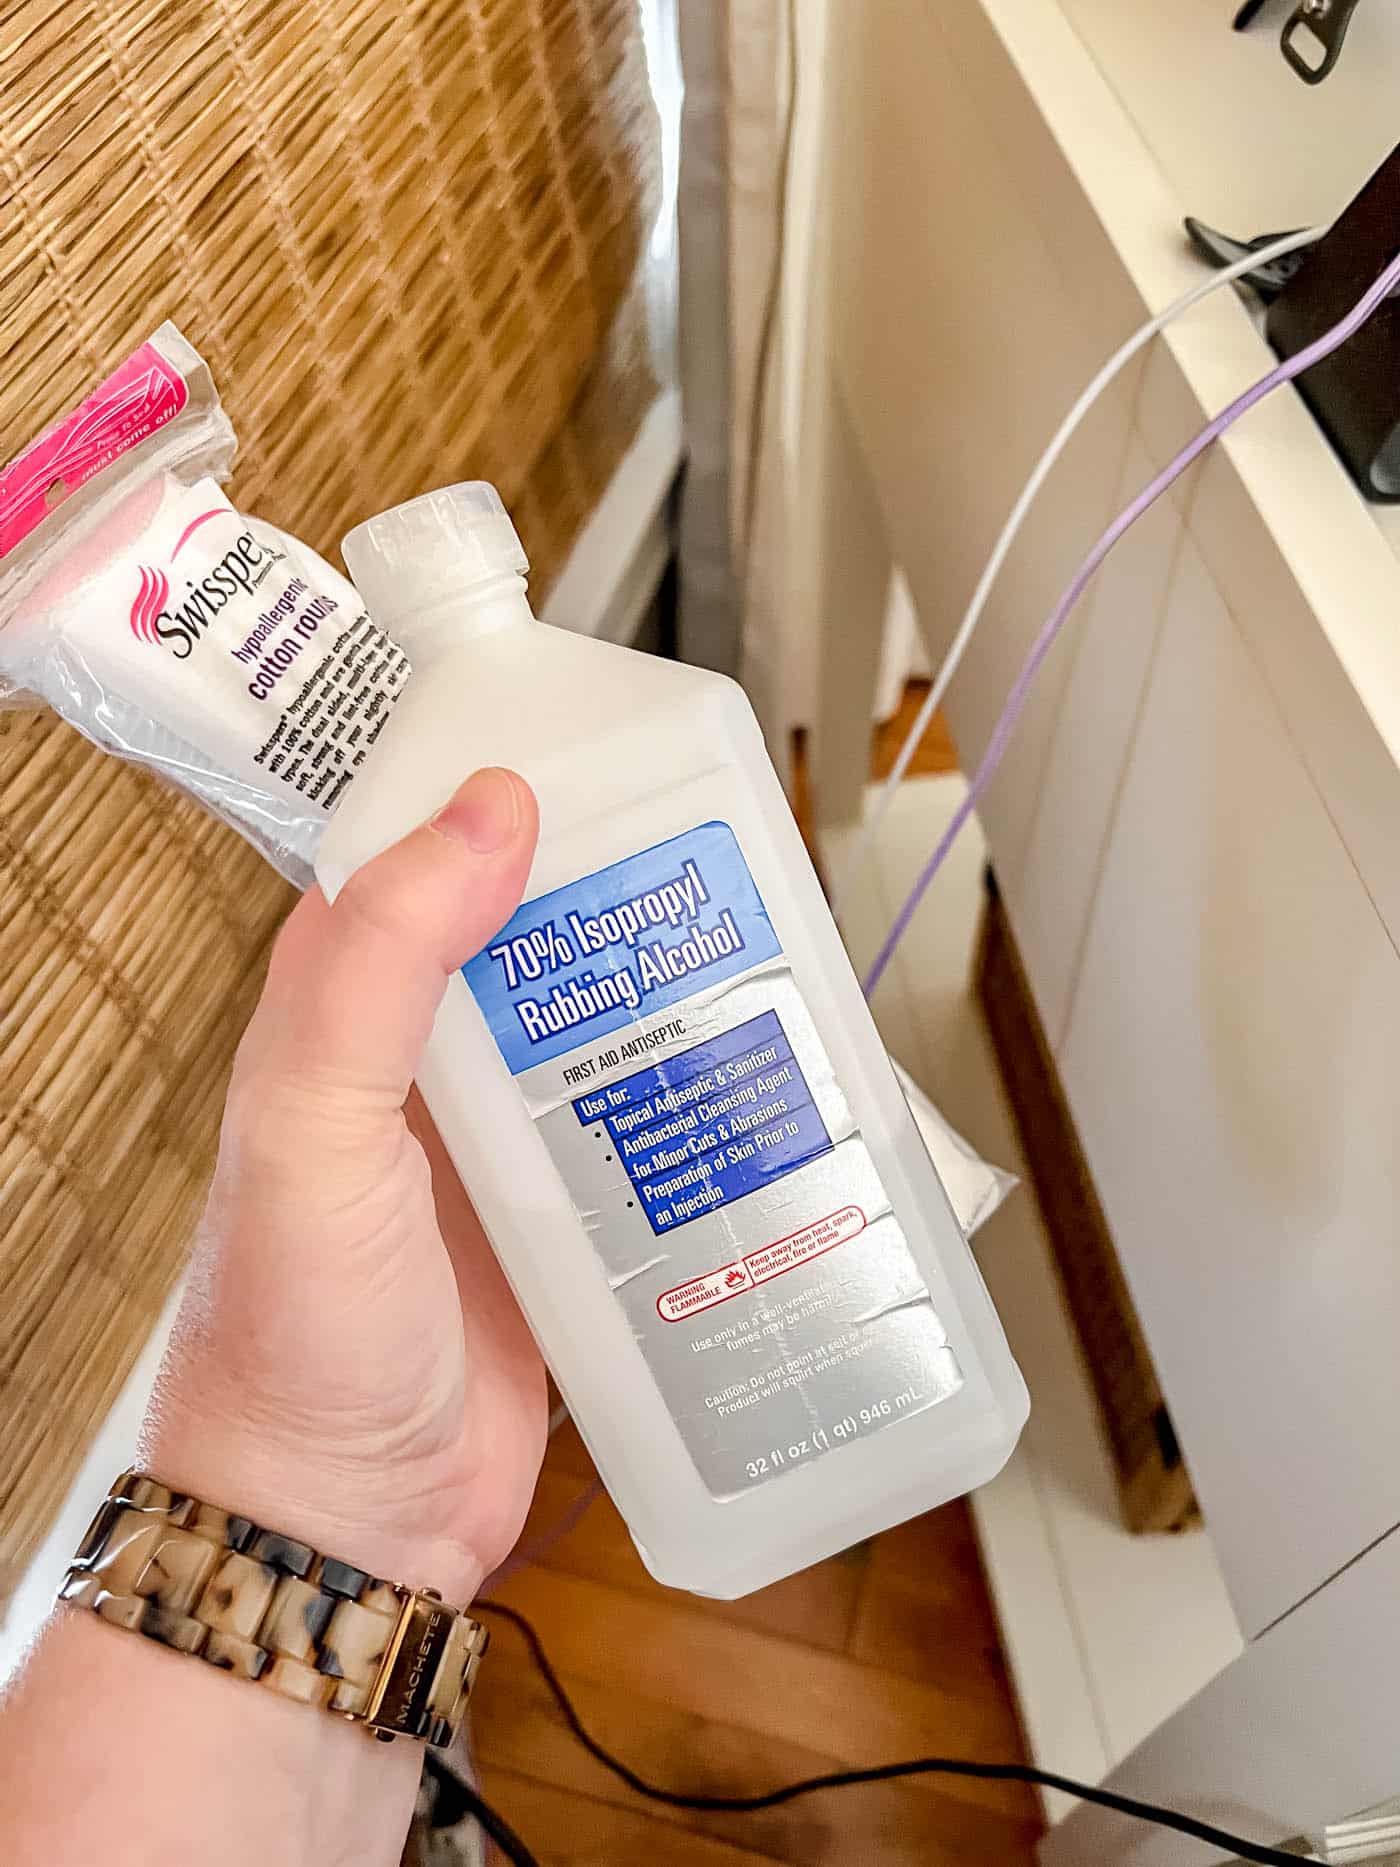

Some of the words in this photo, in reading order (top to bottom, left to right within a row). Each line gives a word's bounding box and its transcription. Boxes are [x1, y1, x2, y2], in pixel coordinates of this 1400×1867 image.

[117, 424, 150, 452] come
[154, 532, 265, 659] Swisspe
[231, 578, 308, 664] hypoallergeni
[248, 637, 303, 700] cotton
[269, 753, 286, 773] with
[299, 699, 323, 728] cotton
[490, 922, 574, 988] 70%
[569, 862, 709, 955] Isopropyl
[517, 970, 638, 1041] Rubbing
[636, 911, 742, 990] Alcohol
[562, 1058, 597, 1086] FIRST
[599, 1049, 621, 1074] AID
[621, 1019, 687, 1060] ANTISEPTIC
[580, 1098, 607, 1118] Use
[609, 1106, 655, 1133] Topical
[655, 1077, 715, 1114] Antiseptic
[716, 1068, 727, 1086] &
[727, 1046, 778, 1079] Sanitizer
[622, 1111, 699, 1157] Antibacterial
[698, 1087, 757, 1127] Cleansing
[757, 1066, 792, 1095] Agent
[633, 1163, 653, 1179] for
[651, 1144, 690, 1172] Minor
[689, 1132, 718, 1155] Cuts
[719, 1123, 731, 1141] &
[730, 1098, 788, 1135] Abrasions
[642, 1162, 713, 1203] Preparation
[715, 1155, 727, 1171] of
[729, 1140, 756, 1164] Skin
[755, 1129, 784, 1152] Prior
[785, 1122, 799, 1138] to
[655, 1208, 673, 1226] an
[672, 1185, 724, 1218] Injection
[749, 1253, 770, 1269] Keep
[770, 1243, 792, 1259] away
[793, 1233, 812, 1247] from
[793, 1246, 807, 1258] fire
[807, 1242, 817, 1251] or
[817, 1230, 840, 1246] flame
[666, 1282, 706, 1305] WARNING
[670, 1286, 722, 1314] FLAMMABLE
[691, 1337, 712, 1353] Use
[714, 1327, 738, 1345] only
[739, 1320, 751, 1332] in
[726, 1332, 762, 1351] fumes
[762, 1319, 785, 1337] may
[785, 1312, 801, 1325] be
[718, 1393, 760, 1417] Product
[762, 1385, 781, 1399] will
[782, 1366, 814, 1389] squirt
[815, 1354, 844, 1372] when
[750, 1375, 766, 1388] Do
[767, 1365, 786, 1381] not
[786, 1352, 814, 1374] point
[745, 1456, 769, 1478] 32
[771, 1449, 785, 1467] fl
[788, 1441, 811, 1459] oz
[812, 1429, 831, 1450] (1
[833, 1415, 859, 1440] qt)
[859, 1399, 892, 1425] 946
[895, 1386, 923, 1410] mL
[397, 1612, 440, 1724] MACHETE
